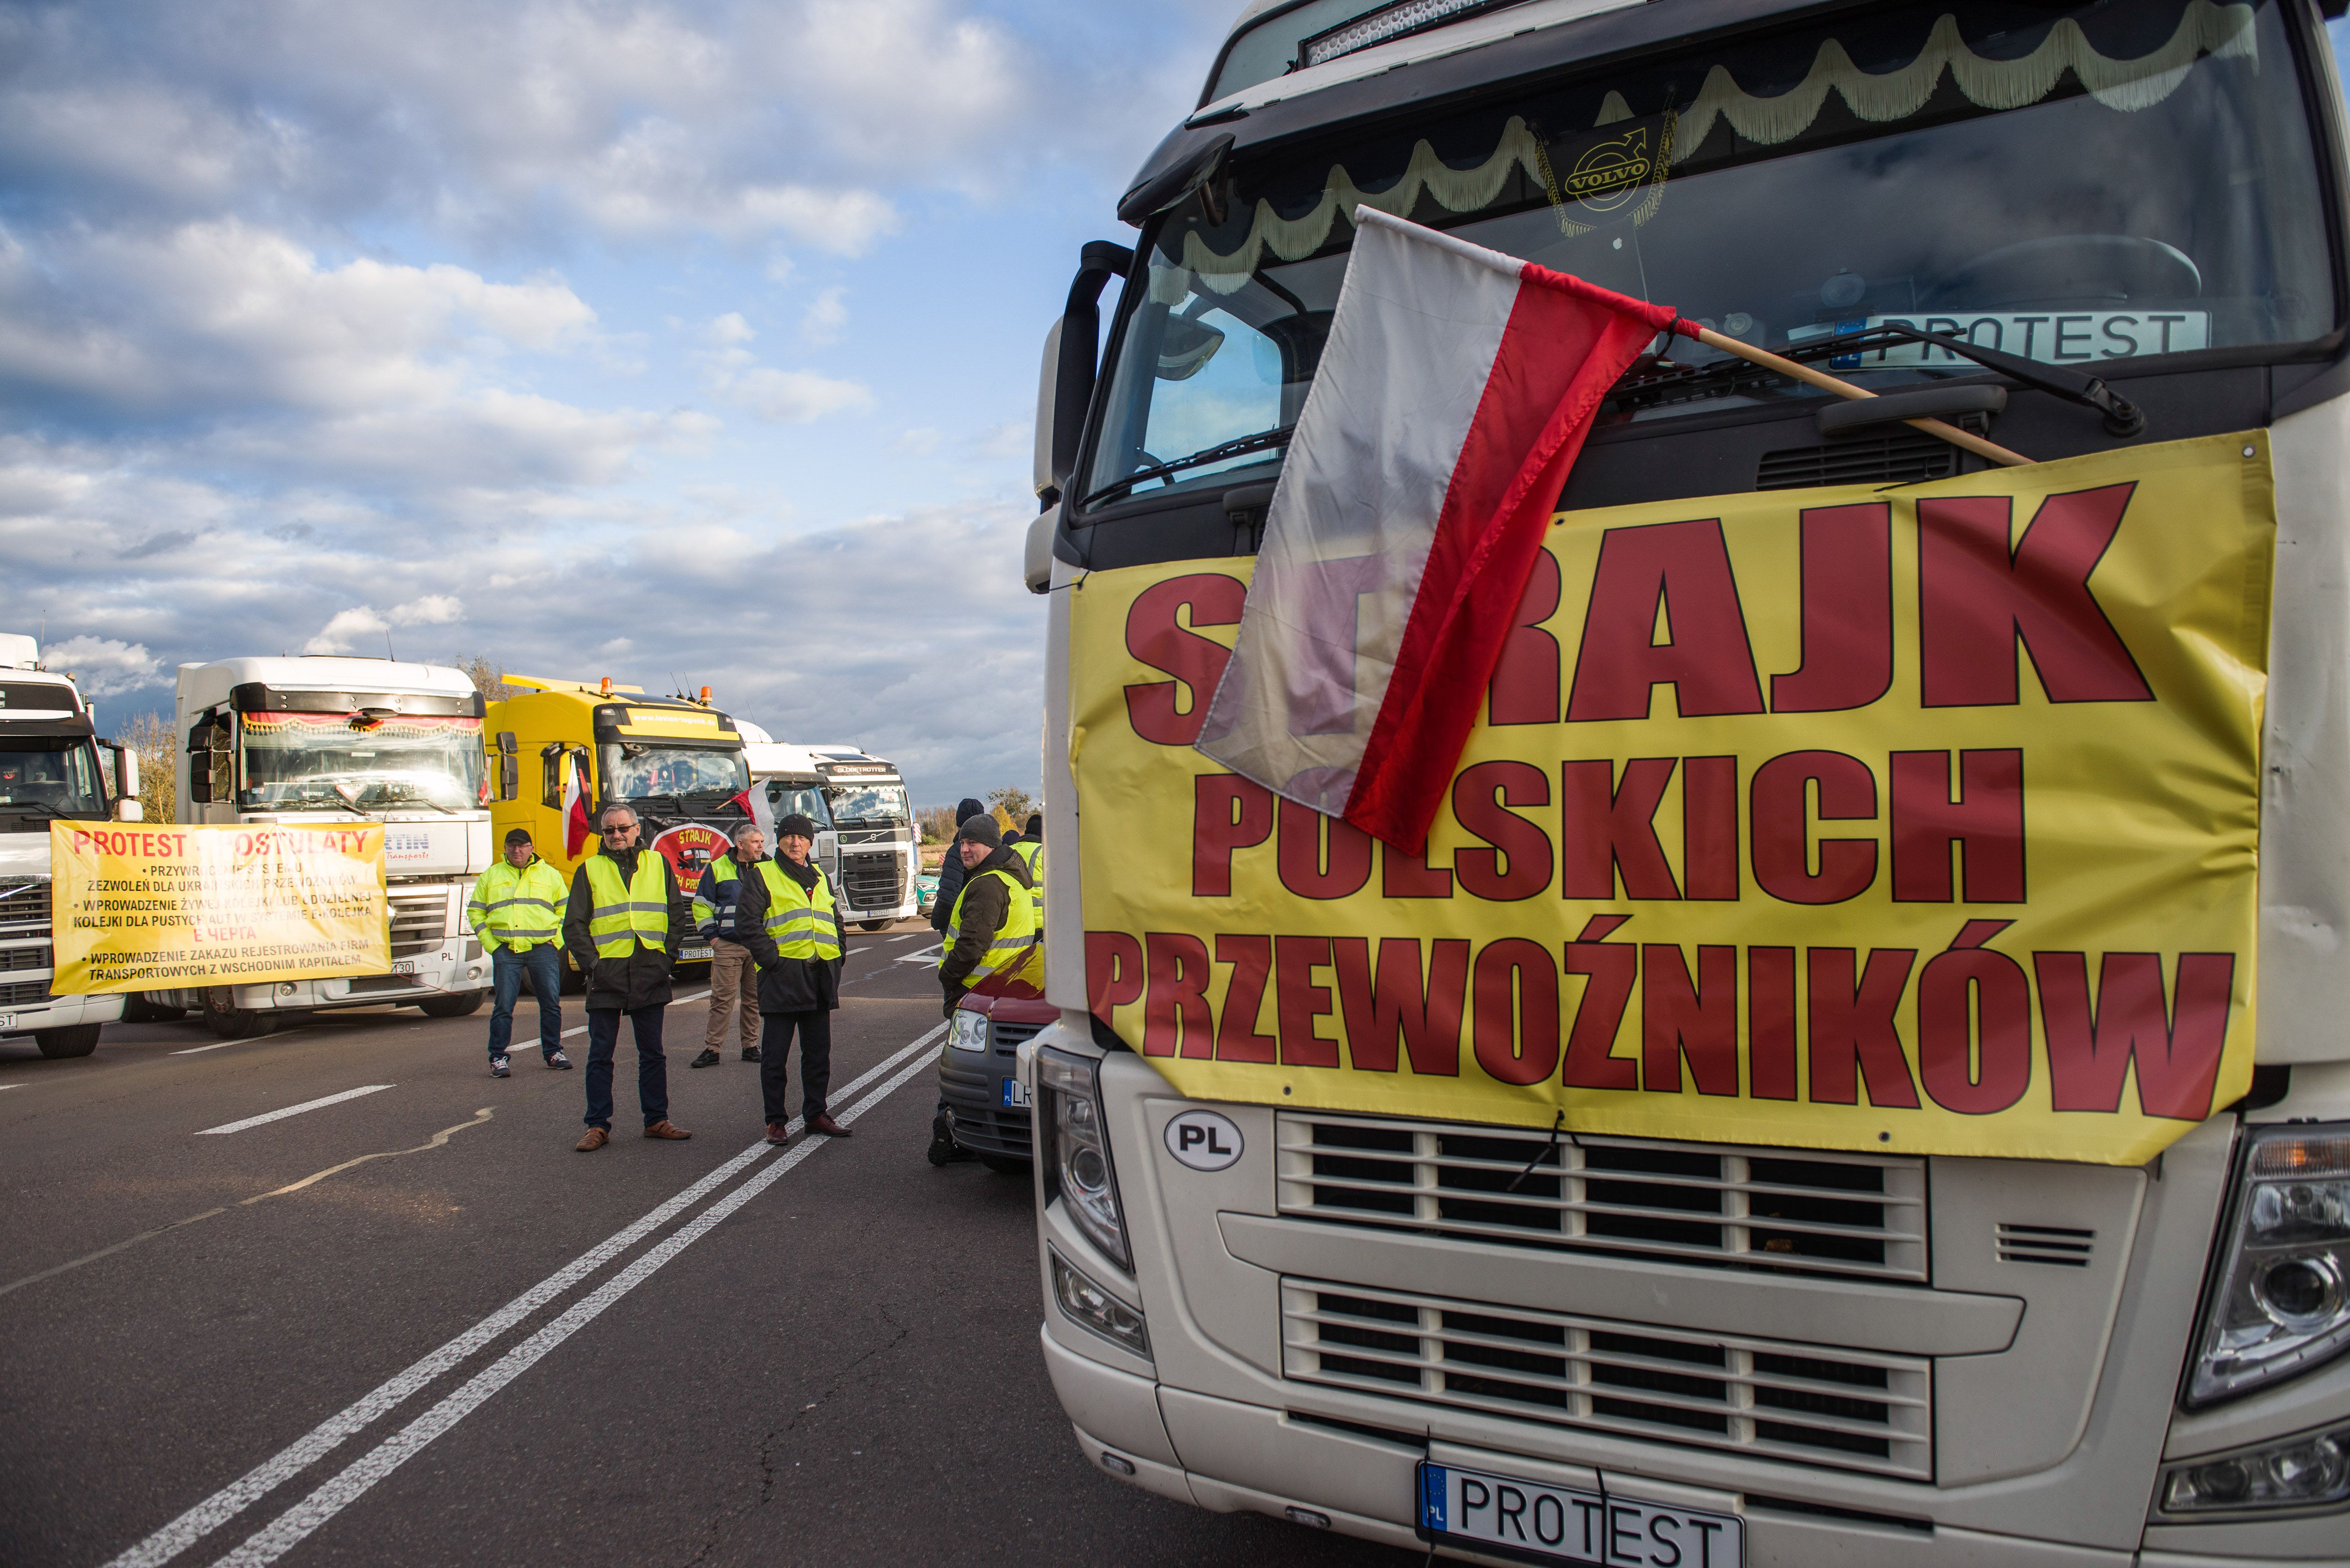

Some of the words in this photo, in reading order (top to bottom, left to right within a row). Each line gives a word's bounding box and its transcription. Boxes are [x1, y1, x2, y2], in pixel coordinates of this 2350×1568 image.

[1570, 163, 1645, 189] VOLVO
[679, 829, 713, 846] STRAJK
[1192, 748, 2027, 906] POLSKICH
[73, 830, 187, 858] PROTEST
[386, 851, 429, 861] Transports
[87, 879, 149, 891] ZEZWOLEŃ
[153, 882, 174, 892] DLA
[83, 899, 177, 912] WPROWADZENIE
[180, 897, 219, 910] ŻYWEJ
[224, 896, 272, 908] KOLEJKI
[276, 894, 298, 905] LUB
[74, 916, 122, 928] KOLEJKI
[126, 916, 149, 927] DLA
[152, 915, 204, 926] PUSTYCH
[209, 913, 233, 925] AUT
[235, 913, 246, 923] W
[251, 909, 307, 923] SYSTEMIE
[311, 906, 372, 920] E-KOLEJKA
[91, 950, 187, 964] WPROWADZENIE
[190, 948, 237, 960] ZAKAZU
[242, 940, 337, 958] REJESTROWANIA
[341, 939, 369, 951] FIRM
[441, 952, 454, 961] PL
[684, 949, 713, 958] PROTEST
[89, 963, 206, 981] TRANSPORTOWYCH
[210, 964, 218, 974] Z
[221, 958, 296, 974] WSCHODNIM
[299, 954, 361, 968] KAPITAŁEM
[1084, 914, 2236, 1122] PRZEWOŹNIKÓW
[1179, 1124, 1231, 1155] PL
[1426, 1505, 1444, 1521] PL
[1461, 1477, 1723, 1568] PROTEST
